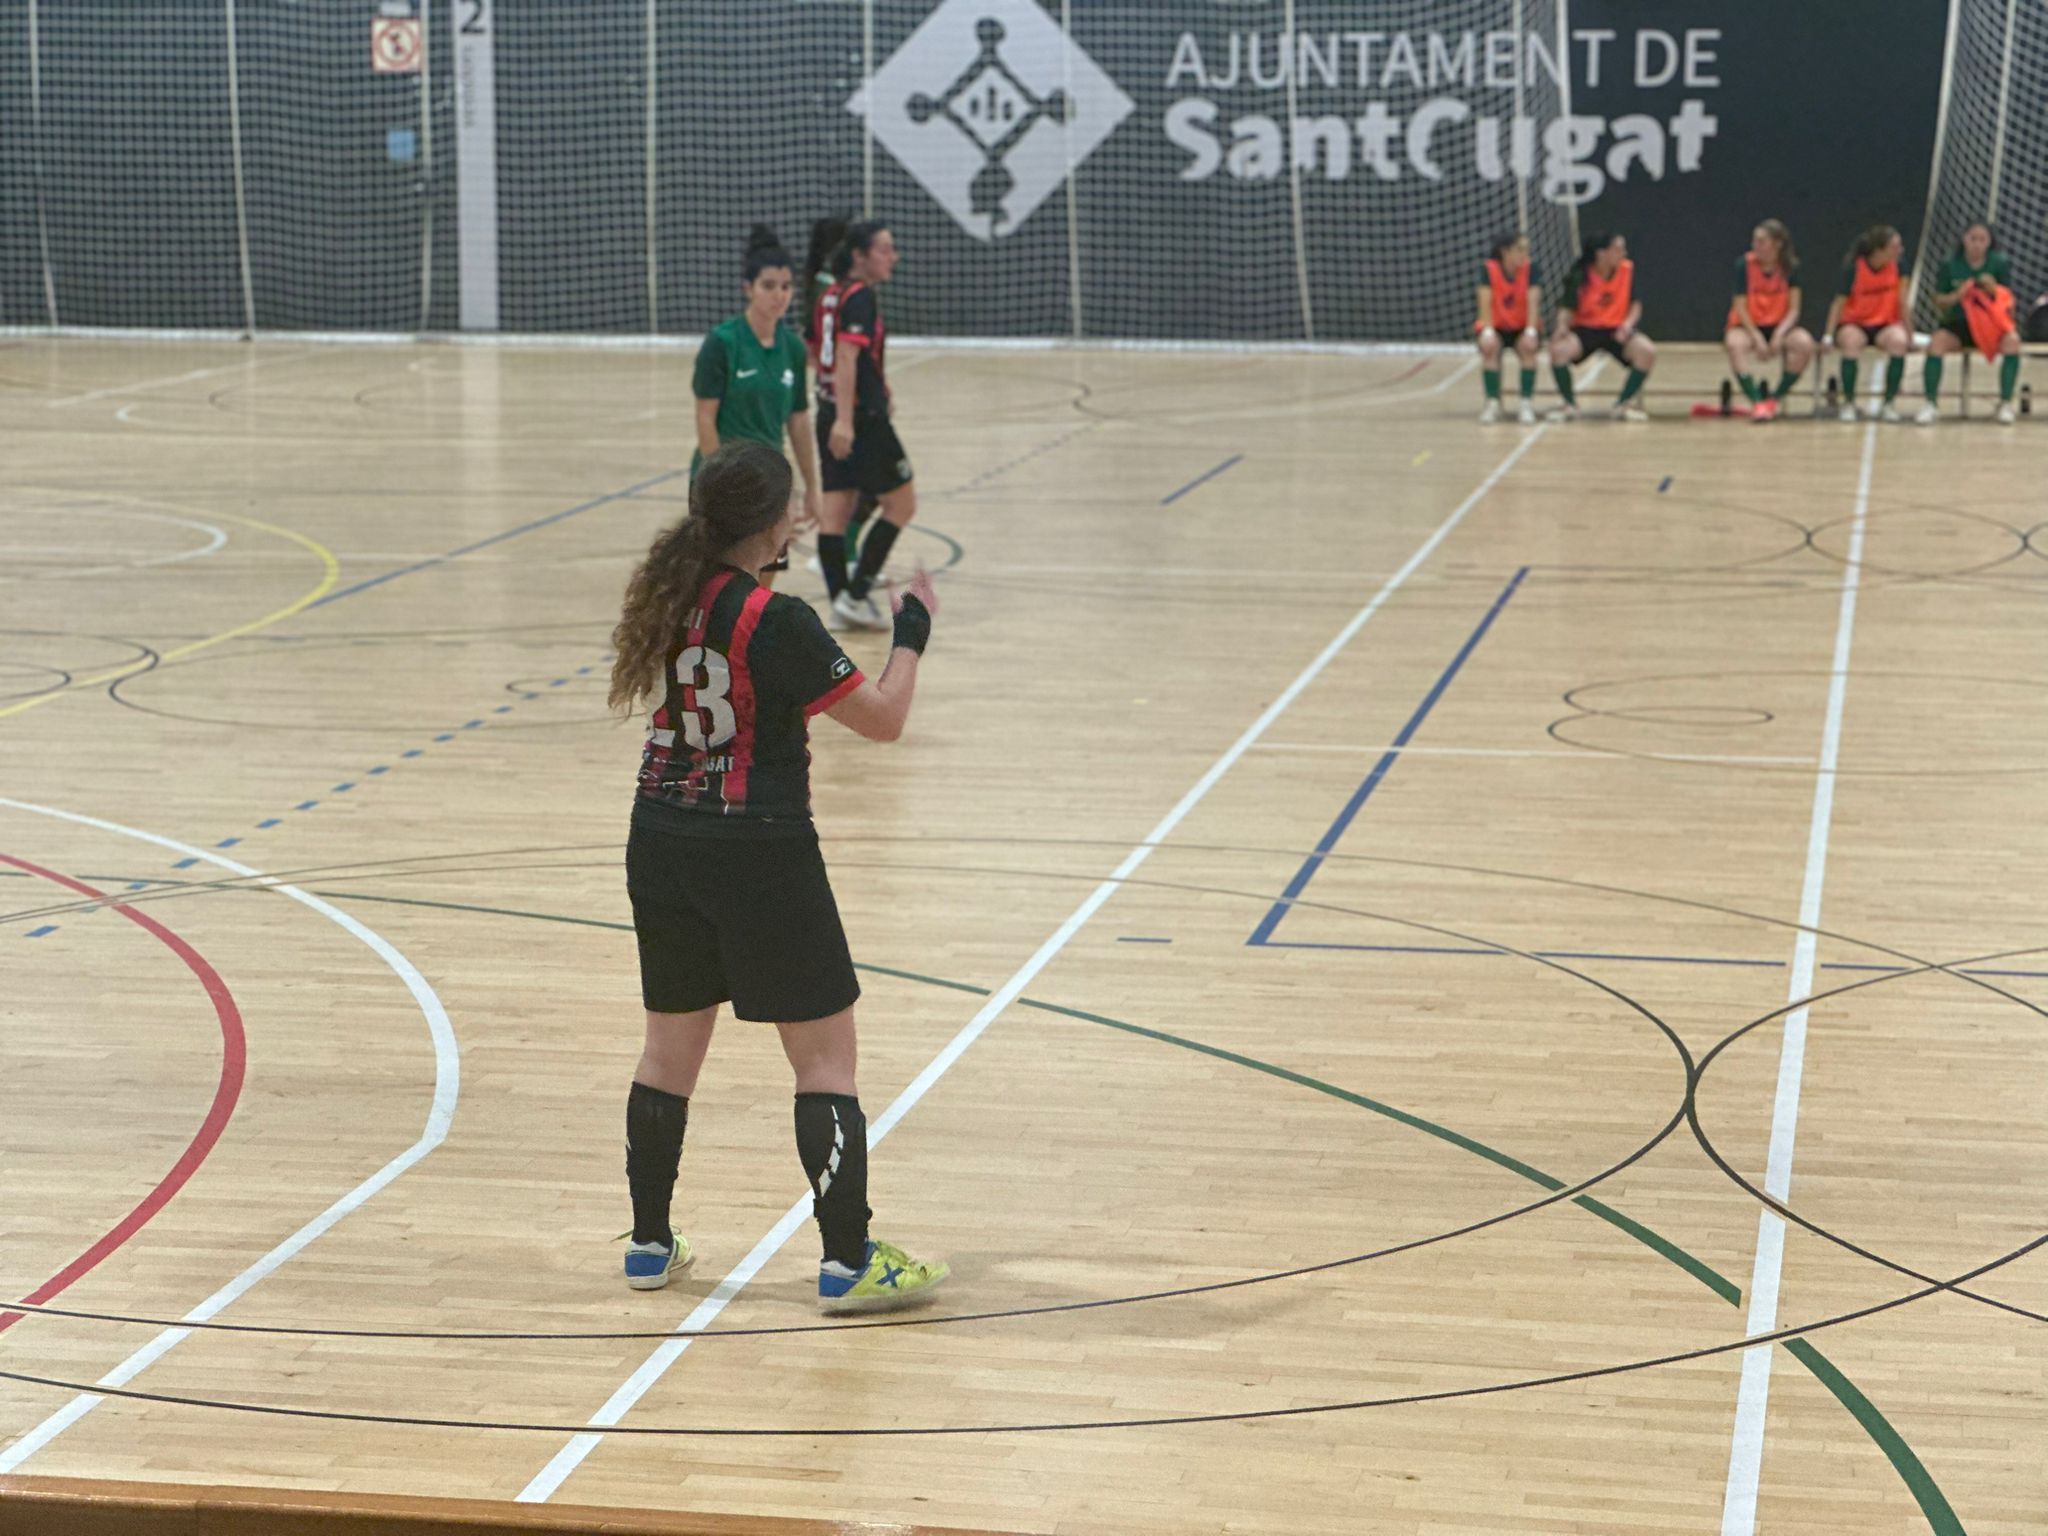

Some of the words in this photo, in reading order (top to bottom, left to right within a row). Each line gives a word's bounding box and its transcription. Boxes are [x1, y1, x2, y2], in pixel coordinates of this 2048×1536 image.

[459, 0, 487, 34] 2
[1165, 29, 1616, 90] AJUNTAMENT
[1635, 29, 1721, 88] DE
